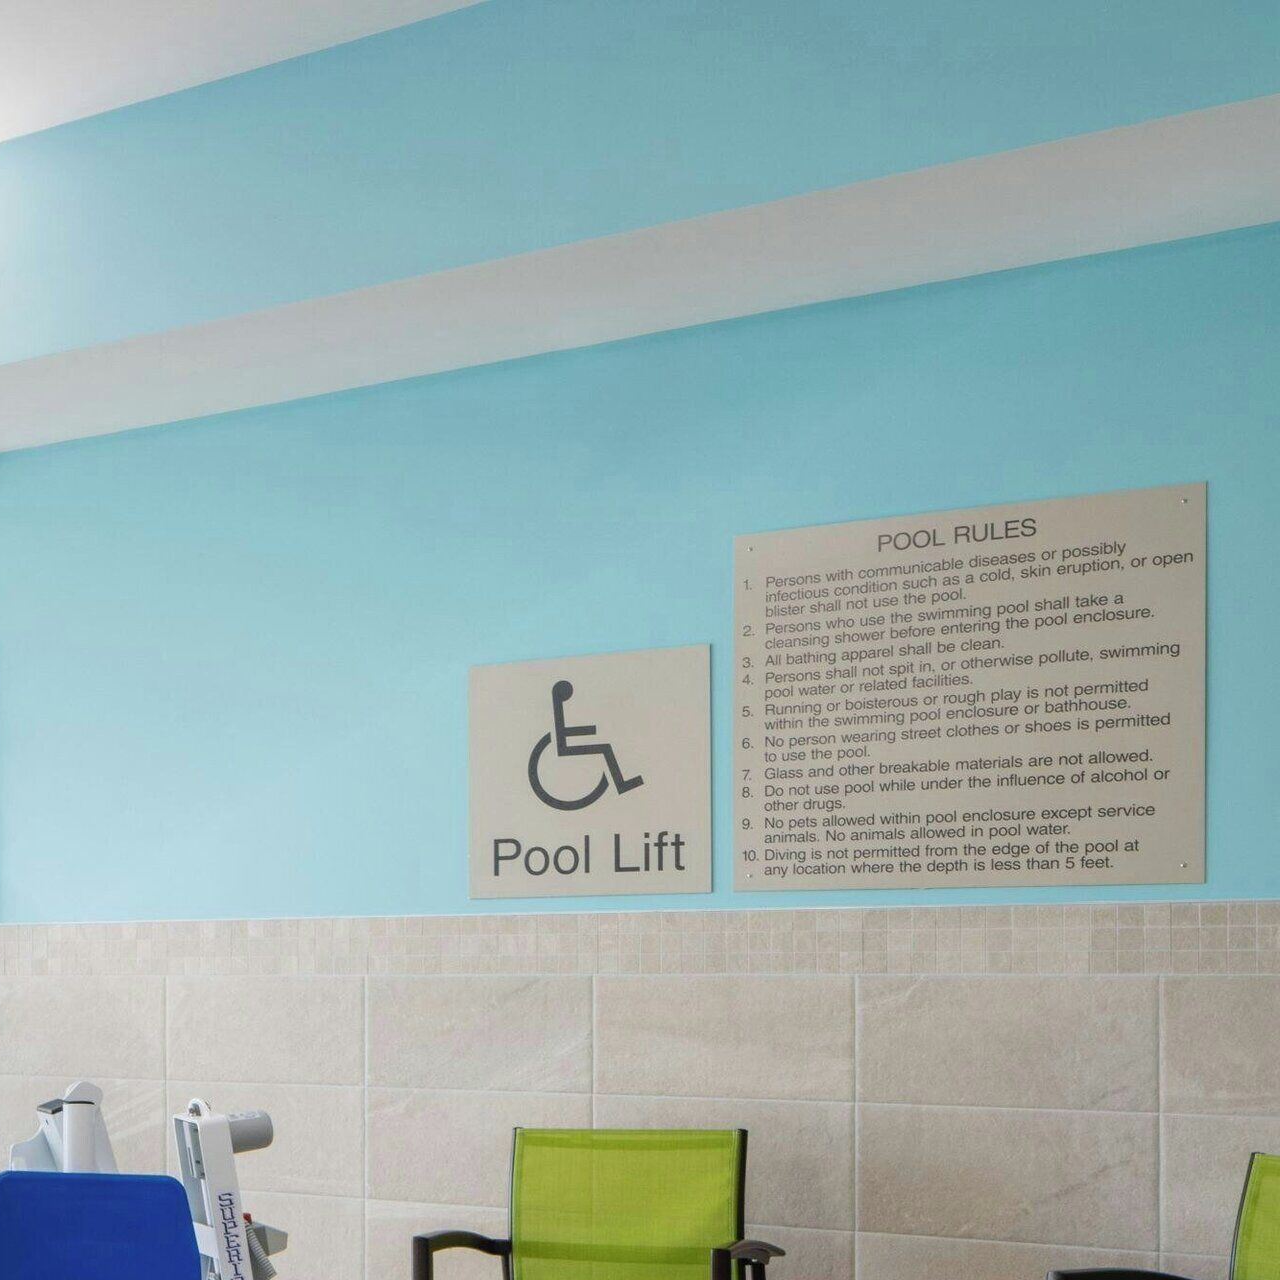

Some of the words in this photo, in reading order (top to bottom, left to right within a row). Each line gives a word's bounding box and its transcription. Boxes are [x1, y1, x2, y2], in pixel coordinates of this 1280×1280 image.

[877, 528, 945, 552] POOL
[954, 518, 1036, 544] RULES
[765, 587, 828, 602] infectious
[833, 581, 897, 596] condition
[902, 575, 936, 589] such
[942, 575, 959, 586] as
[965, 574, 974, 584] a
[979, 567, 1014, 582] cold,
[1020, 564, 1050, 578] skin
[1056, 558, 1124, 575] eruption,
[1130, 556, 1147, 567] or
[1151, 552, 1193, 568] open
[766, 574, 821, 587] Persons
[825, 568, 853, 581] with
[857, 557, 963, 579] communicable
[968, 552, 1035, 568] diseases
[1040, 549, 1057, 560] or
[1061, 540, 1126, 562] possibly
[765, 605, 805, 617] blister
[809, 599, 840, 613] shall
[846, 597, 867, 609] not
[873, 596, 898, 607] use
[903, 592, 926, 604] the
[931, 587, 966, 605] pool.
[765, 621, 820, 634] Persons
[825, 617, 854, 629] who
[859, 615, 885, 626] use
[890, 611, 912, 623] the
[917, 604, 991, 621] swimming
[996, 599, 1028, 618] pool
[1034, 596, 1069, 611] shall
[1075, 594, 1108, 607] take
[1111, 594, 1124, 604] a
[764, 634, 829, 649] cleansing
[834, 630, 885, 643] shower
[890, 625, 935, 638] before
[940, 619, 1000, 635] entering
[1005, 616, 1029, 629] the
[1034, 612, 1067, 630] pool
[1072, 607, 1154, 623] enclosure.
[764, 654, 781, 666] All
[786, 651, 836, 664] bathing
[841, 645, 893, 663] apparel
[898, 642, 931, 656] shall
[937, 641, 955, 653] be
[960, 638, 1004, 651] clean.
[764, 685, 793, 701] pool
[798, 684, 835, 695] water
[839, 683, 854, 693] or
[859, 677, 907, 691] related
[912, 673, 972, 688] facilities.
[764, 701, 821, 715] Running
[826, 701, 840, 711] or
[845, 696, 918, 710] boisterous
[922, 695, 938, 705] or
[943, 690, 985, 706] rough
[990, 688, 1021, 704] play
[1026, 686, 1038, 698] is
[1044, 684, 1068, 697] not
[1073, 678, 1148, 698] permitted
[764, 735, 784, 747] No
[788, 735, 835, 749] person
[840, 730, 895, 746] wearing
[900, 726, 941, 740] street
[946, 724, 999, 737] clothes
[1004, 724, 1020, 734] or
[1024, 720, 1071, 733] shoes
[1077, 717, 1089, 730] is
[1095, 712, 1170, 732] permitted
[764, 751, 777, 762] to
[781, 751, 806, 761] use
[811, 748, 832, 759] the
[837, 745, 870, 761] pool.
[764, 767, 803, 779] Glass
[807, 764, 833, 777] and
[838, 763, 874, 776] other
[879, 759, 950, 774] breakable
[955, 755, 1023, 770] materials
[1027, 756, 1053, 767] are
[1058, 752, 1083, 765] not
[1088, 748, 1152, 764] allowed.
[764, 784, 783, 797] Do
[788, 784, 809, 795] not
[814, 784, 839, 794] use
[844, 780, 874, 796] pool
[879, 779, 915, 791] while
[920, 777, 963, 790] under
[967, 775, 991, 788] the
[996, 773, 1065, 786] influence
[1070, 770, 1085, 783] of
[1090, 767, 1147, 783] alcohol
[1153, 769, 1170, 780] or
[763, 799, 799, 811] other
[802, 798, 845, 812] drugs.
[764, 816, 783, 828] No
[788, 816, 817, 830] pets
[822, 813, 874, 827] allowed
[879, 811, 920, 824] within
[925, 809, 956, 826] pool
[962, 808, 1035, 822] enclosure
[1040, 805, 1092, 821] except
[1097, 803, 1155, 817] service
[764, 830, 819, 843] animals.
[825, 829, 845, 841] No
[850, 827, 905, 841] animals
[909, 825, 965, 839] allowed
[970, 824, 983, 836] in
[988, 823, 1020, 840] pool
[1026, 823, 1070, 835] water.
[493, 835, 590, 877] Pool
[614, 831, 686, 873] Lift
[764, 848, 806, 864] Diving
[811, 847, 822, 859] is
[826, 847, 848, 859] not
[853, 844, 919, 862] permitted
[924, 844, 957, 856] from
[963, 843, 986, 856] the
[991, 842, 1030, 859] edge
[1035, 841, 1049, 854] of
[1054, 840, 1079, 853] the
[1084, 839, 1118, 855] pool
[1123, 839, 1139, 851] at
[763, 866, 788, 878] any
[792, 862, 845, 875] location
[850, 861, 893, 873] where
[899, 860, 921, 872] the
[926, 859, 967, 874] depth
[973, 858, 985, 871] is
[990, 858, 1020, 870] less
[1026, 857, 1059, 870] than
[1065, 856, 1075, 869] 5
[1079, 856, 1113, 868] feet.
